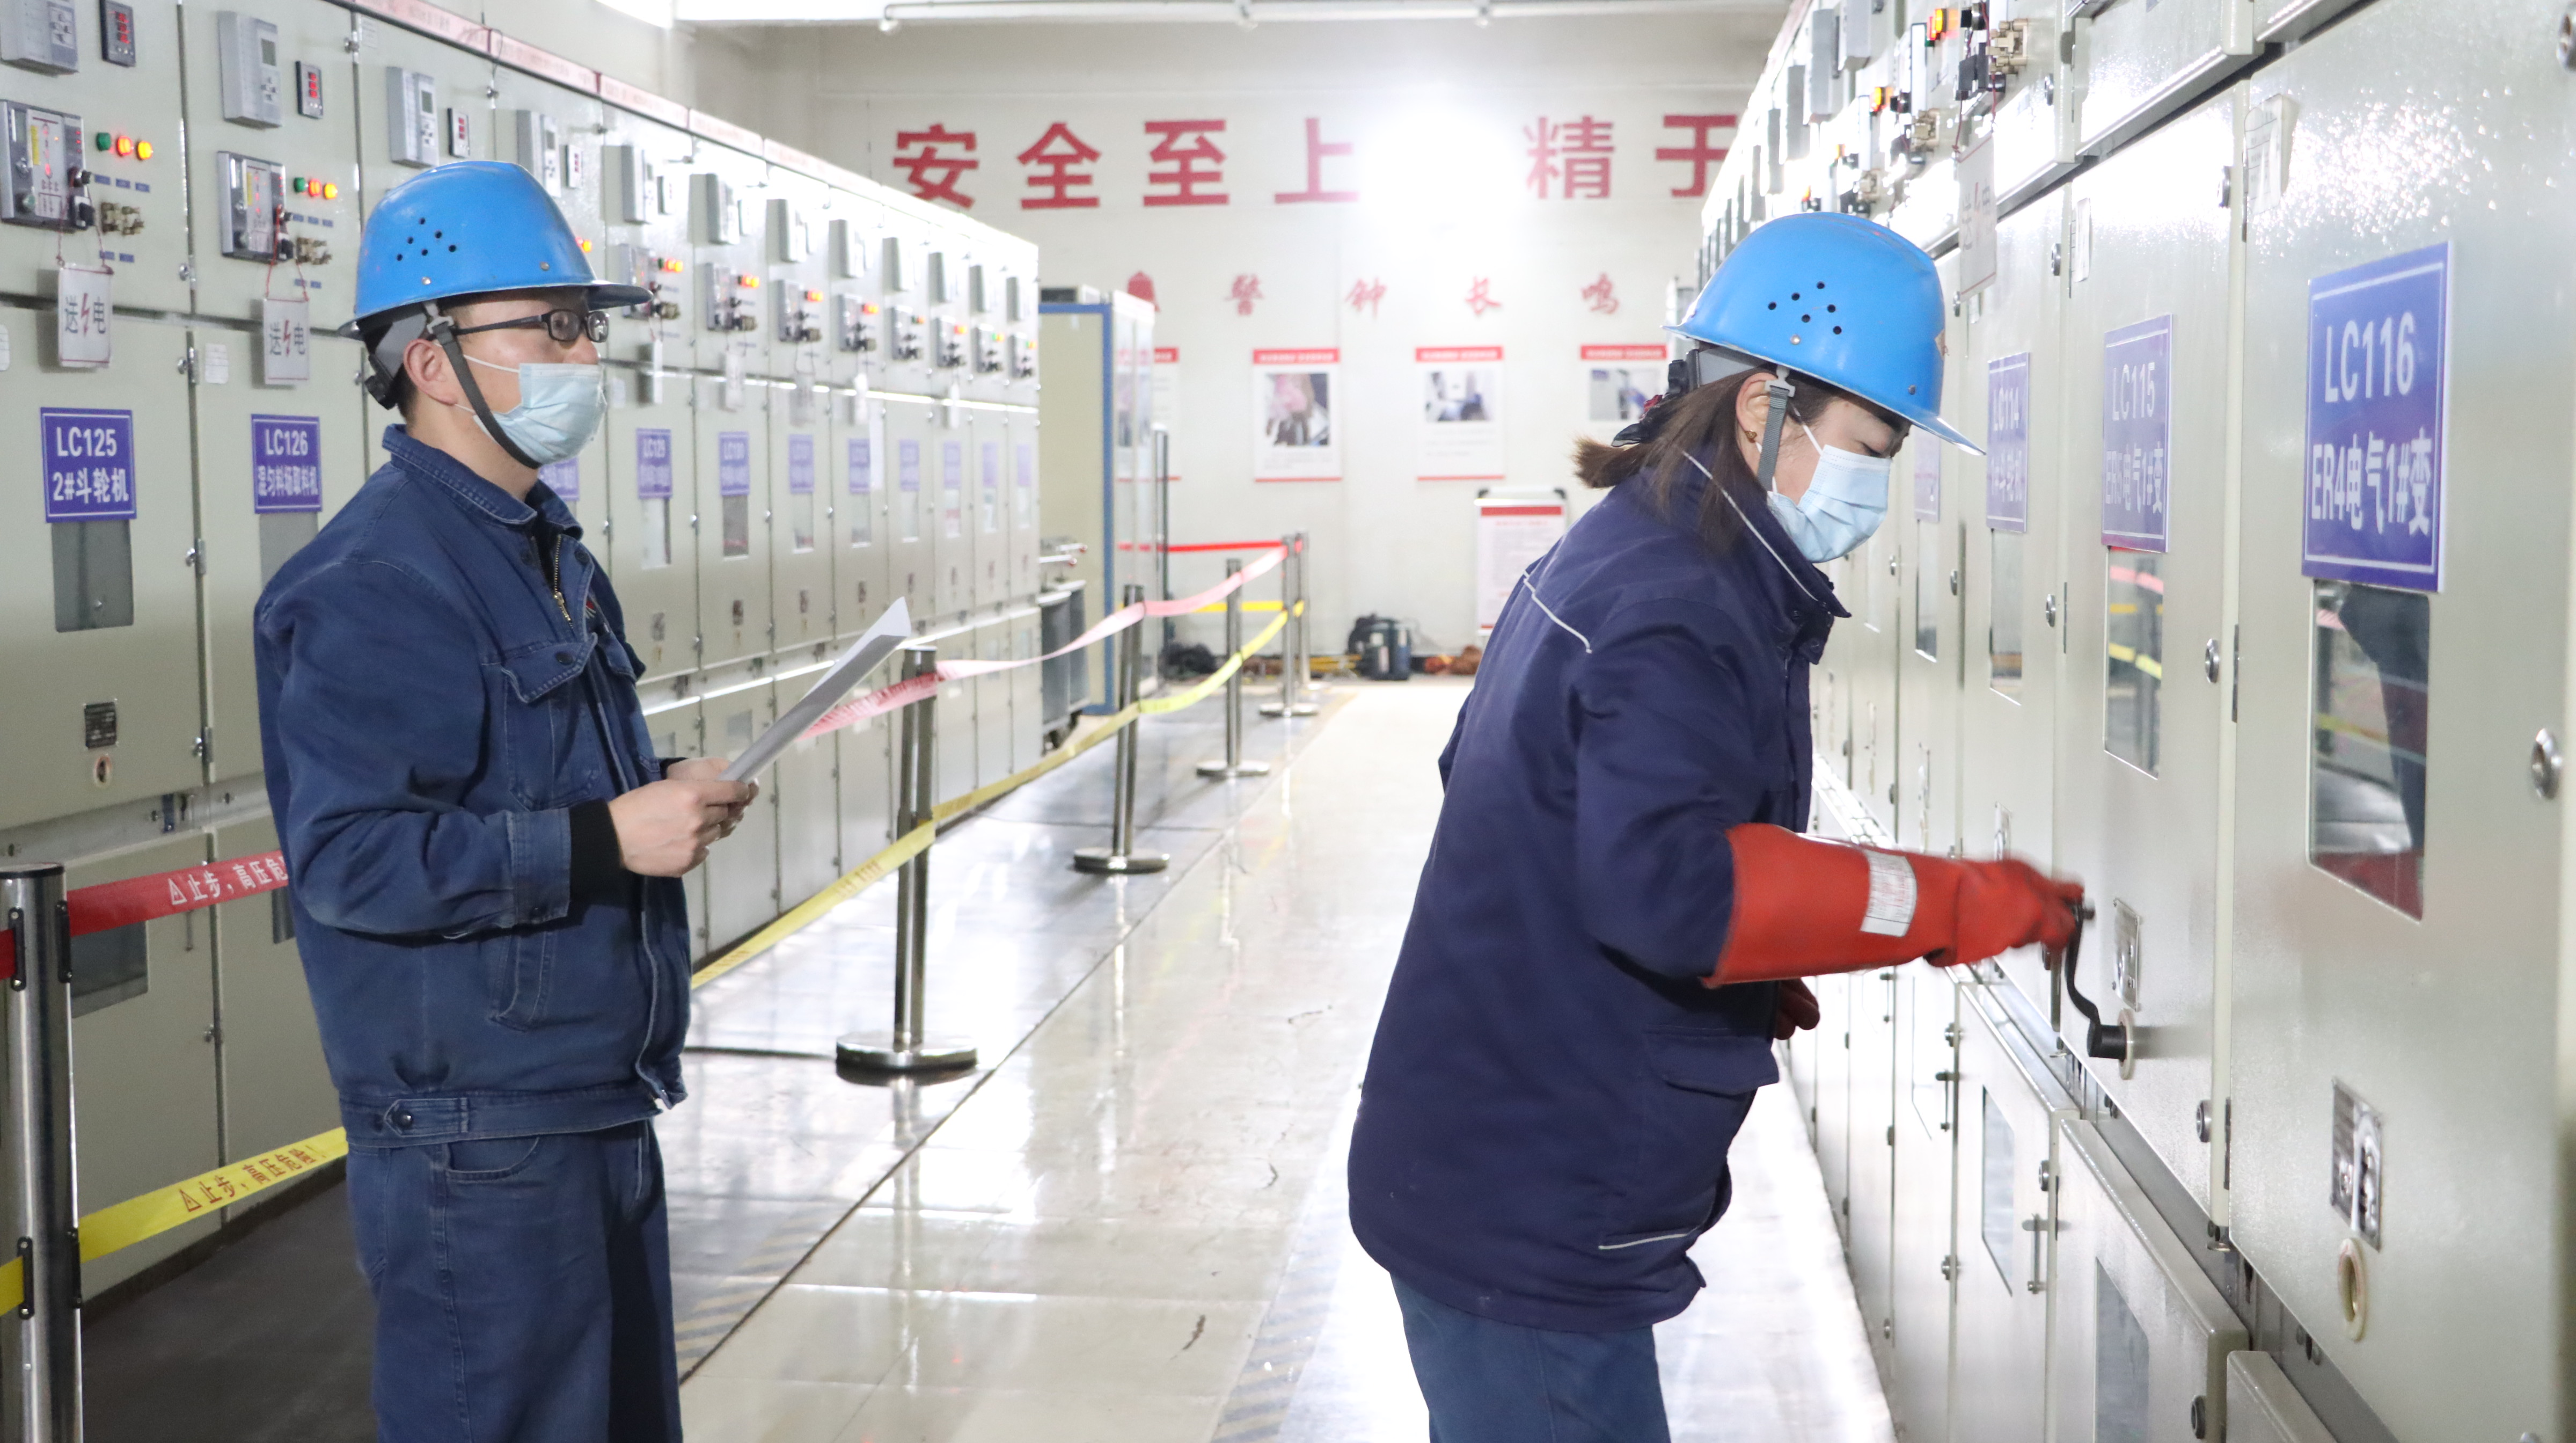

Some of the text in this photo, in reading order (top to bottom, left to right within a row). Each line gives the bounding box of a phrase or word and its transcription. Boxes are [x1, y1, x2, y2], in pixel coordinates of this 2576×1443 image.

[892, 117, 1360, 210] 安全至上
[2324, 310, 2415, 403] LC116
[2112, 361, 2156, 421] LC115
[56, 426, 118, 457] LC125
[265, 428, 309, 456] LC126
[53, 467, 129, 504] 2#斗轮机
[2311, 426, 2433, 536] ER4电气1#变
[188, 856, 289, 901] 止步，高压危
